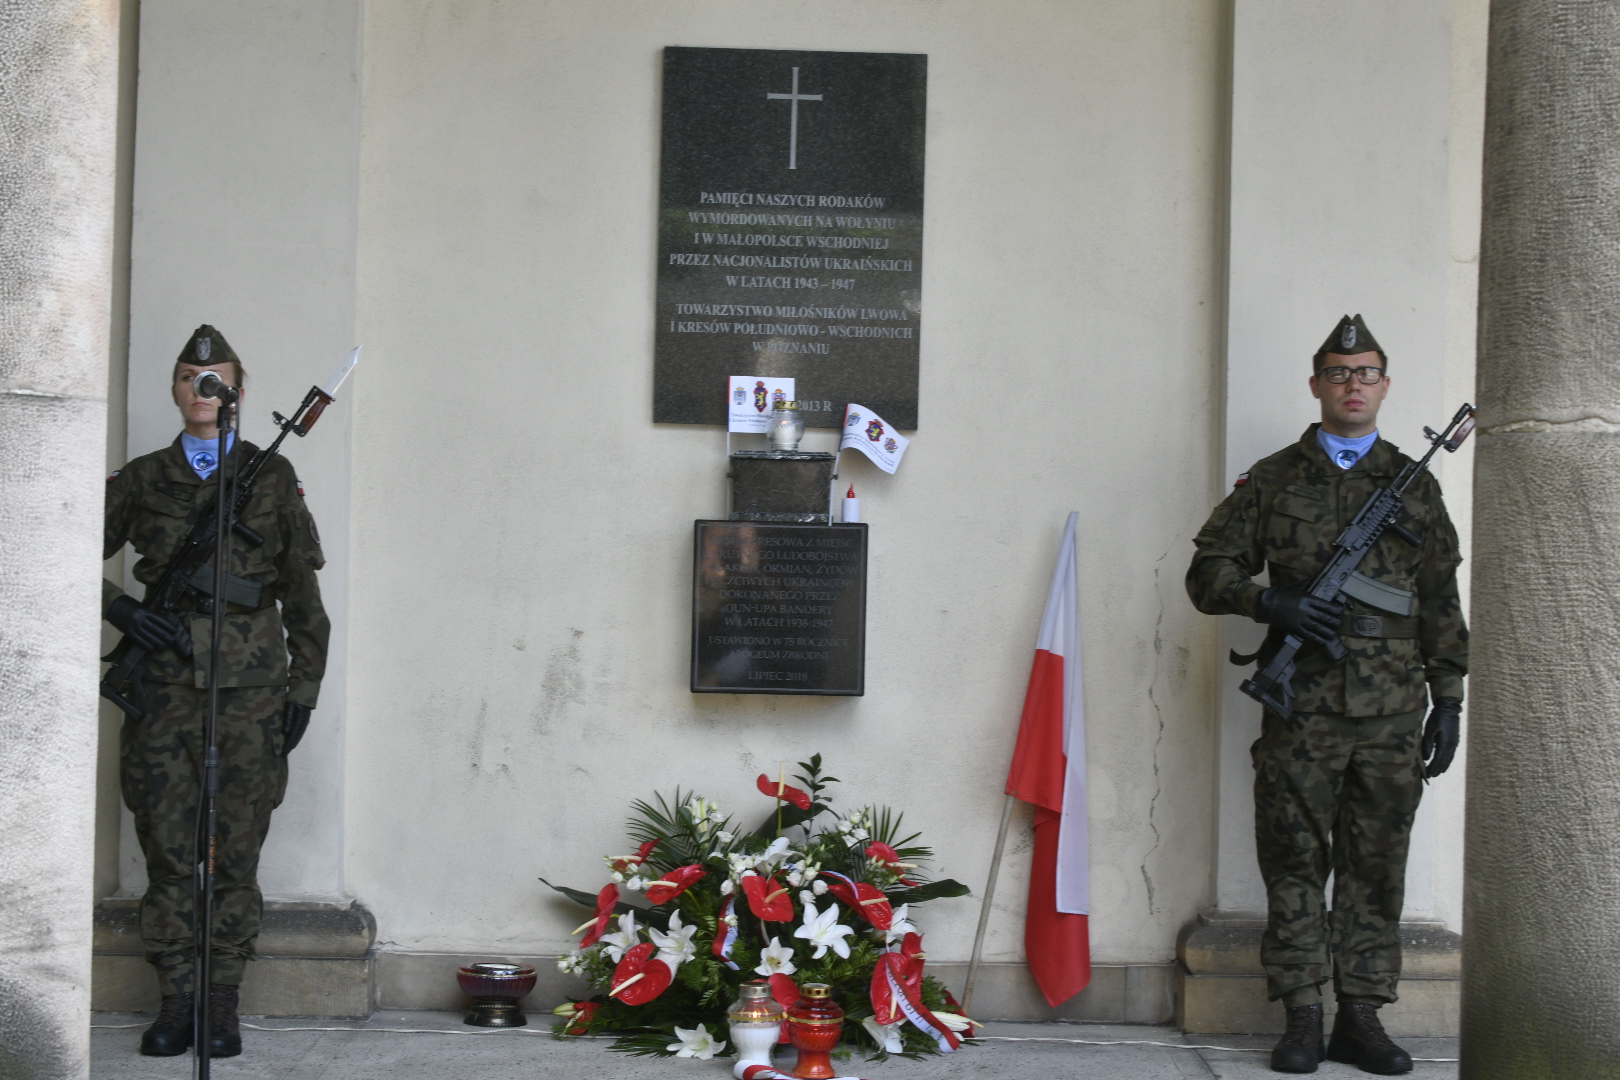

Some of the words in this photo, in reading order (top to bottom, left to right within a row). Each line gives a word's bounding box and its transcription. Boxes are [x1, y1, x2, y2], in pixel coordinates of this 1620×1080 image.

[700, 192, 753, 207] PAMIĘCI
[756, 194, 815, 207] NASZYCH
[819, 193, 886, 209] RODAKÓW
[688, 212, 812, 227] WYMORDOWANYCH
[816, 215, 833, 228] NA
[836, 216, 897, 229] WOŁYNIU
[694, 233, 700, 244] I
[702, 233, 715, 244] W
[717, 233, 803, 247] MAŁOPOLSCE
[806, 236, 889, 250] WSCHODNIEJ
[669, 254, 709, 266] PRZEZ
[713, 254, 822, 269] NACJONALISTÓW
[825, 256, 913, 272] UKRAIŃSKICH
[726, 275, 739, 287] W
[741, 276, 791, 289] LATACH
[795, 278, 819, 290] 1943
[831, 279, 855, 290] 1947
[676, 303, 773, 317] TOWARZYSTWO
[775, 305, 858, 320] MIŁOŚNIKÓW
[861, 308, 908, 321] LWOWA
[670, 320, 676, 332] I
[678, 320, 730, 334] KRESÓW
[733, 322, 819, 337] POŁUDNIOWO
[828, 325, 913, 339] WSCHODNICH
[752, 341, 765, 352] W
[767, 342, 830, 355] POZNANIU
[806, 538, 814, 547] Z
[777, 550, 858, 562] LUDOBÓJSTWA
[719, 589, 803, 600] DOKONANEGO
[805, 591, 841, 601] PRZEZ
[725, 603, 777, 613] OUN-UPA
[780, 604, 834, 615] BANDERY
[737, 617, 784, 627] LATACH
[708, 636, 771, 645] USTAWIONO
[772, 637, 782, 645] W
[784, 637, 795, 646] 75
[782, 650, 829, 660] ZBRODNI
[748, 671, 783, 681] LIPIEC
[785, 672, 809, 682] 2018
